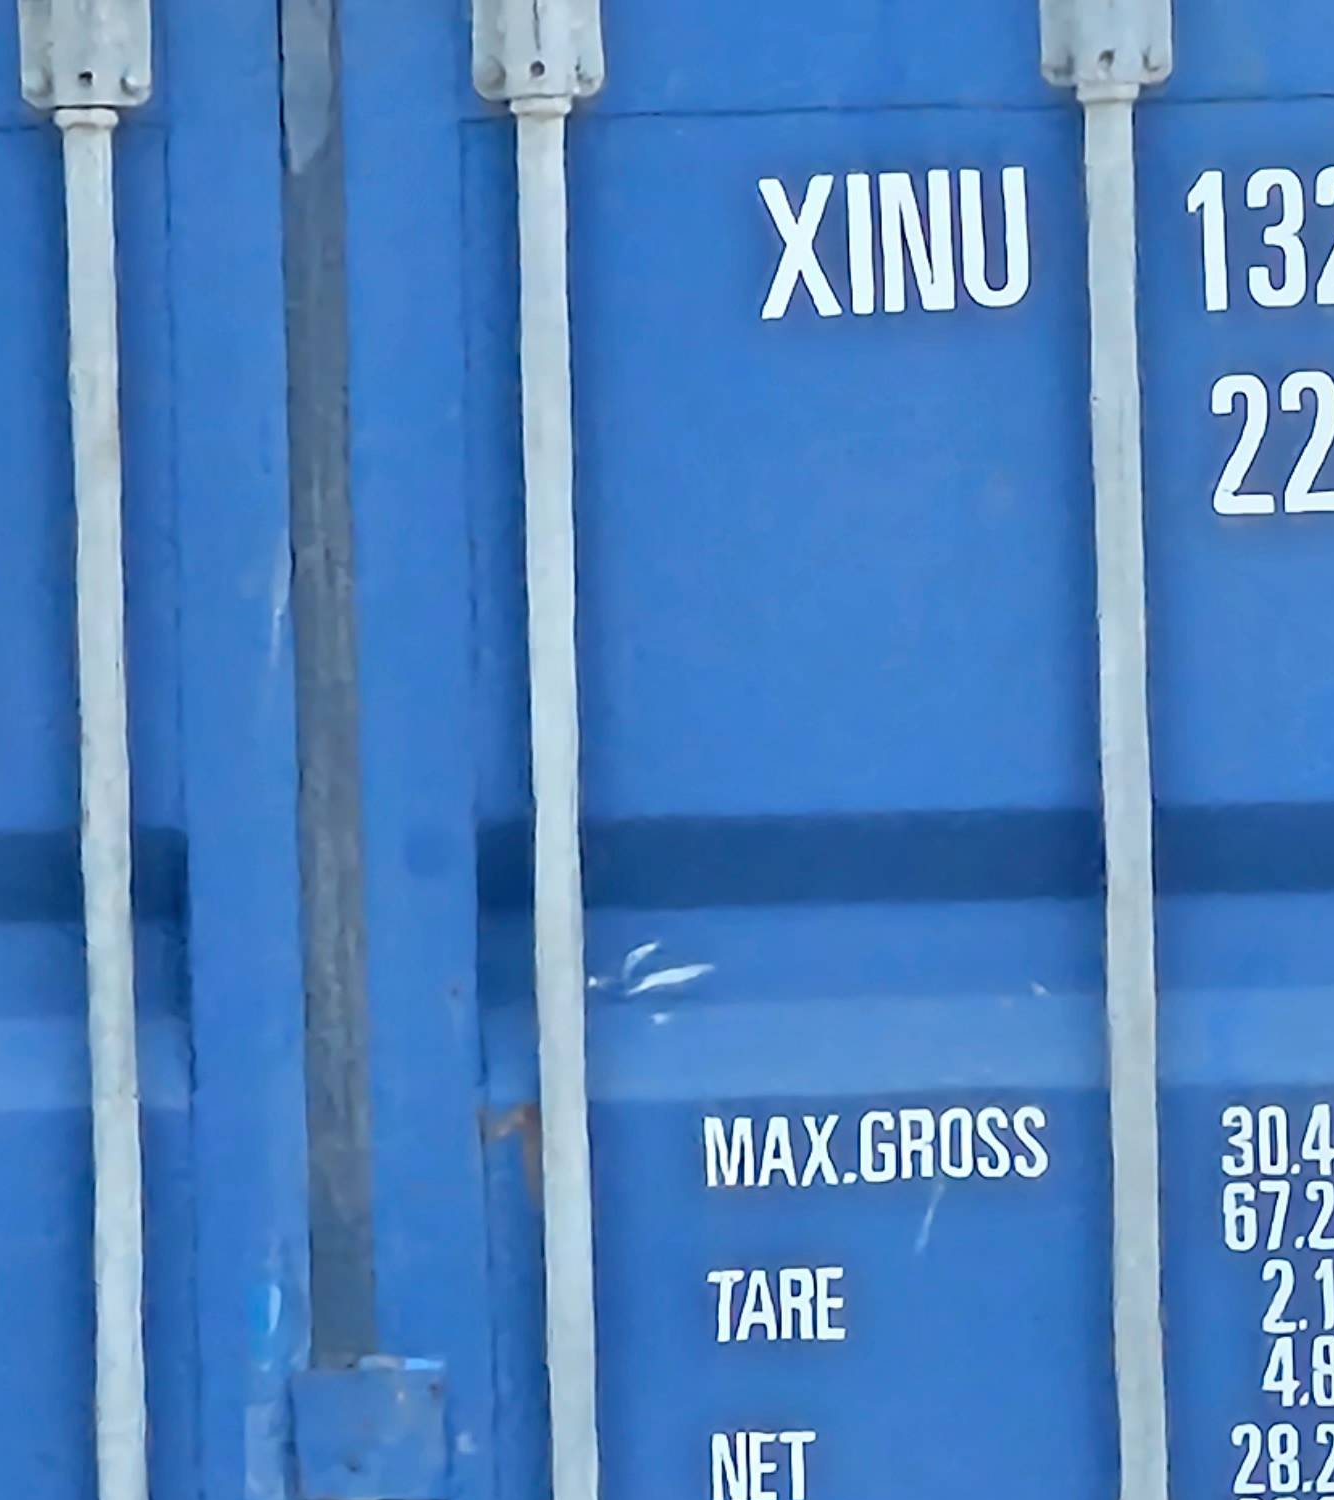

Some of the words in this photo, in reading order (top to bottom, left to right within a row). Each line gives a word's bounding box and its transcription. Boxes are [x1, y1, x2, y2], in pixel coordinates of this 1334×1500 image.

[757, 166, 1030, 320] XINU
[703, 1104, 1049, 1188] MAX.GROSS
[707, 1266, 847, 1344] TARE
